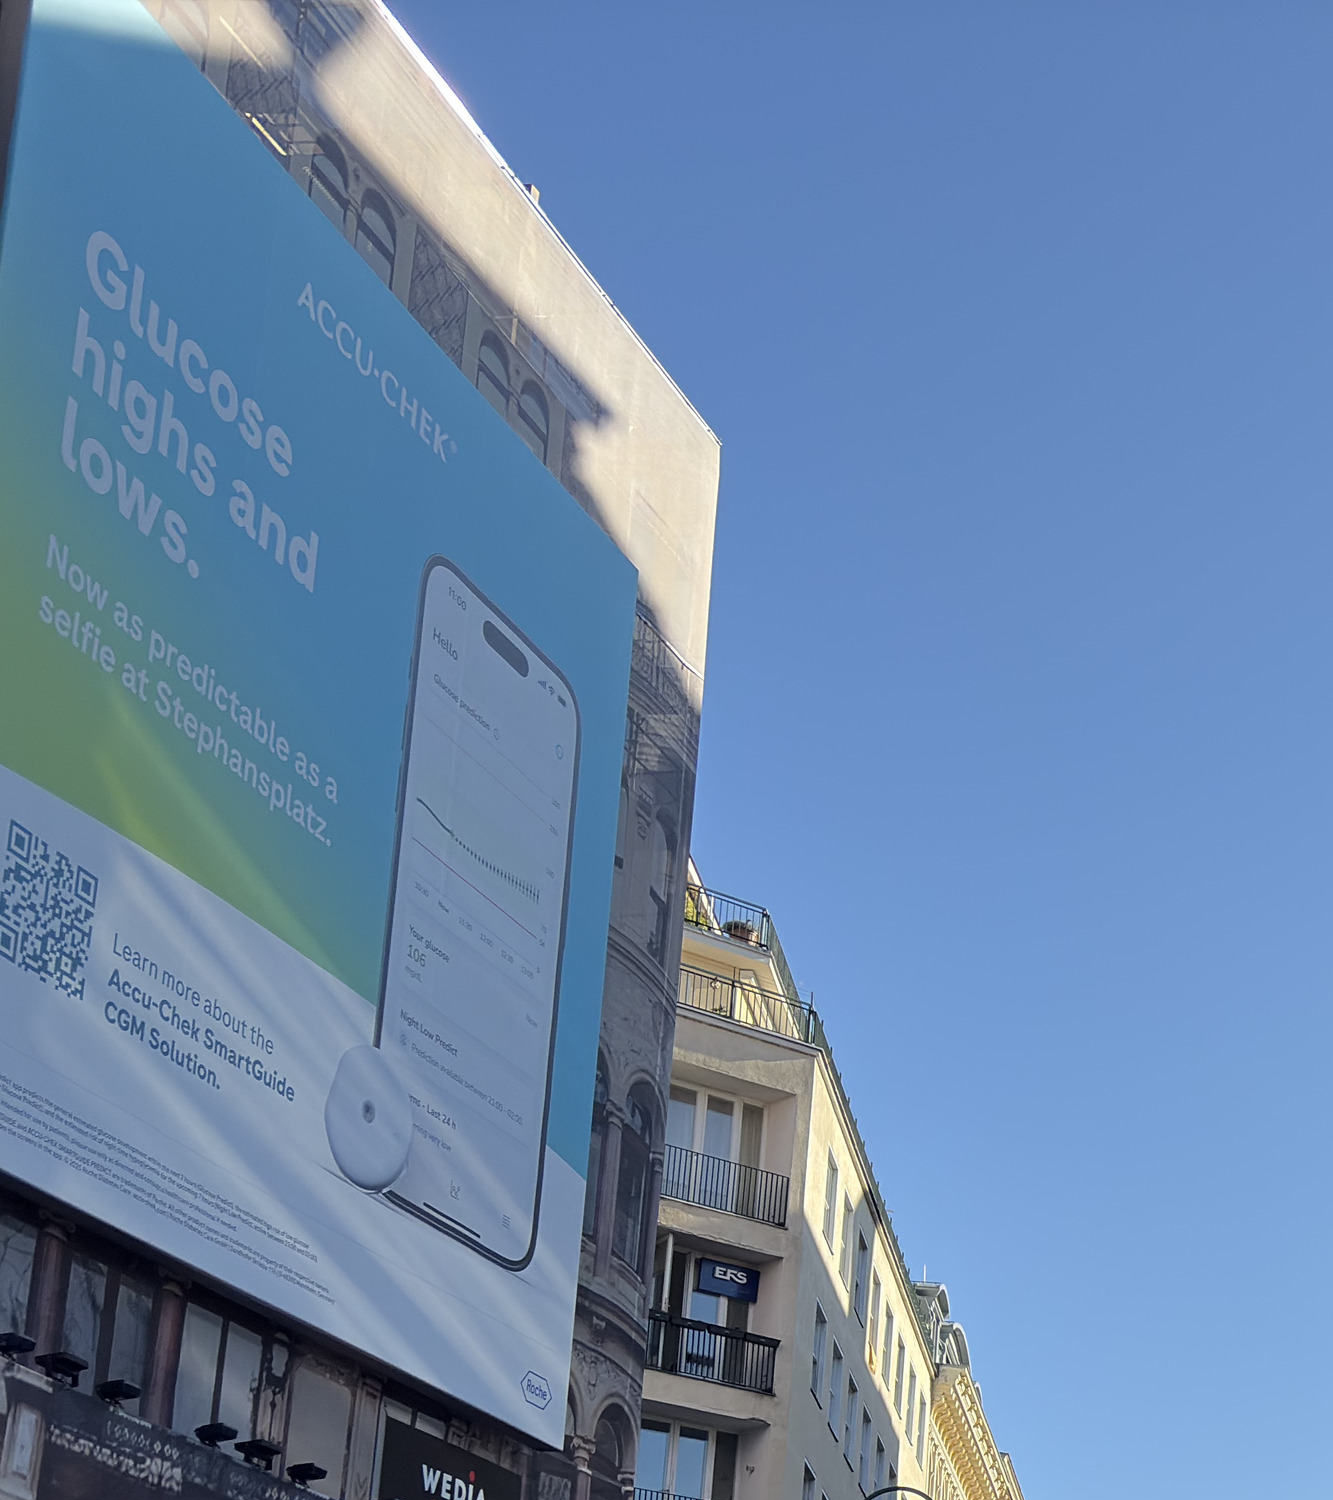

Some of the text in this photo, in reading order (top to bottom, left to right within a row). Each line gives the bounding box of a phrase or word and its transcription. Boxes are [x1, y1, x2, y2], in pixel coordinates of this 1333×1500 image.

[86, 231, 293, 477] Glucose
[61, 396, 200, 579] lows.
[72, 306, 319, 593] highs and
[46, 534, 338, 804] Now as predictable as a
[433, 627, 458, 661] Hello
[39, 596, 332, 847] selfie at Stephansplatz.
[113, 932, 274, 1054] Learn more about the
[407, 944, 426, 967] 106
[104, 1001, 220, 1090] CGM Solution.
[107, 968, 295, 1102] Accu-Chek SmartGuide
[400, 1009, 458, 1057] Night Low Predict
[525, 1379, 548, 1401] Roche
